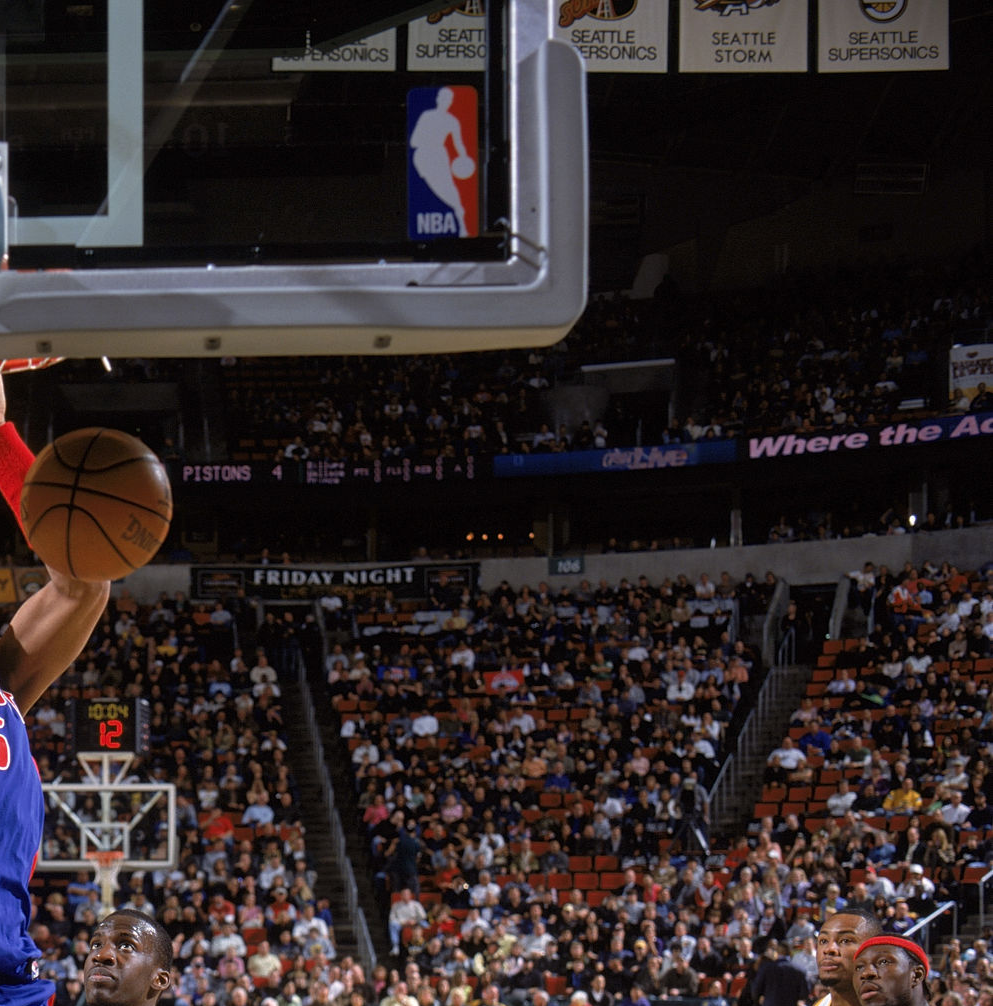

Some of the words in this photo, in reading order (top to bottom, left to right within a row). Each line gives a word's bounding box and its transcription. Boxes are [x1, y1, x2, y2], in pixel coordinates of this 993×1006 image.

[571, 30, 635, 44] SEATTLE
[711, 31, 776, 46] SEATTLE
[848, 31, 918, 45] SEATTLE
[714, 48, 774, 63] STORM
[827, 46, 940, 62] SUPERSONICS
[416, 211, 457, 235] NBA
[749, 430, 869, 460] Where
[878, 422, 942, 446] the
[182, 464, 252, 482] PISTONS
[271, 465, 283, 481] 4
[253, 568, 336, 586] FRIDAY
[342, 566, 416, 585] NIGHT
[99, 719, 123, 749] 12
